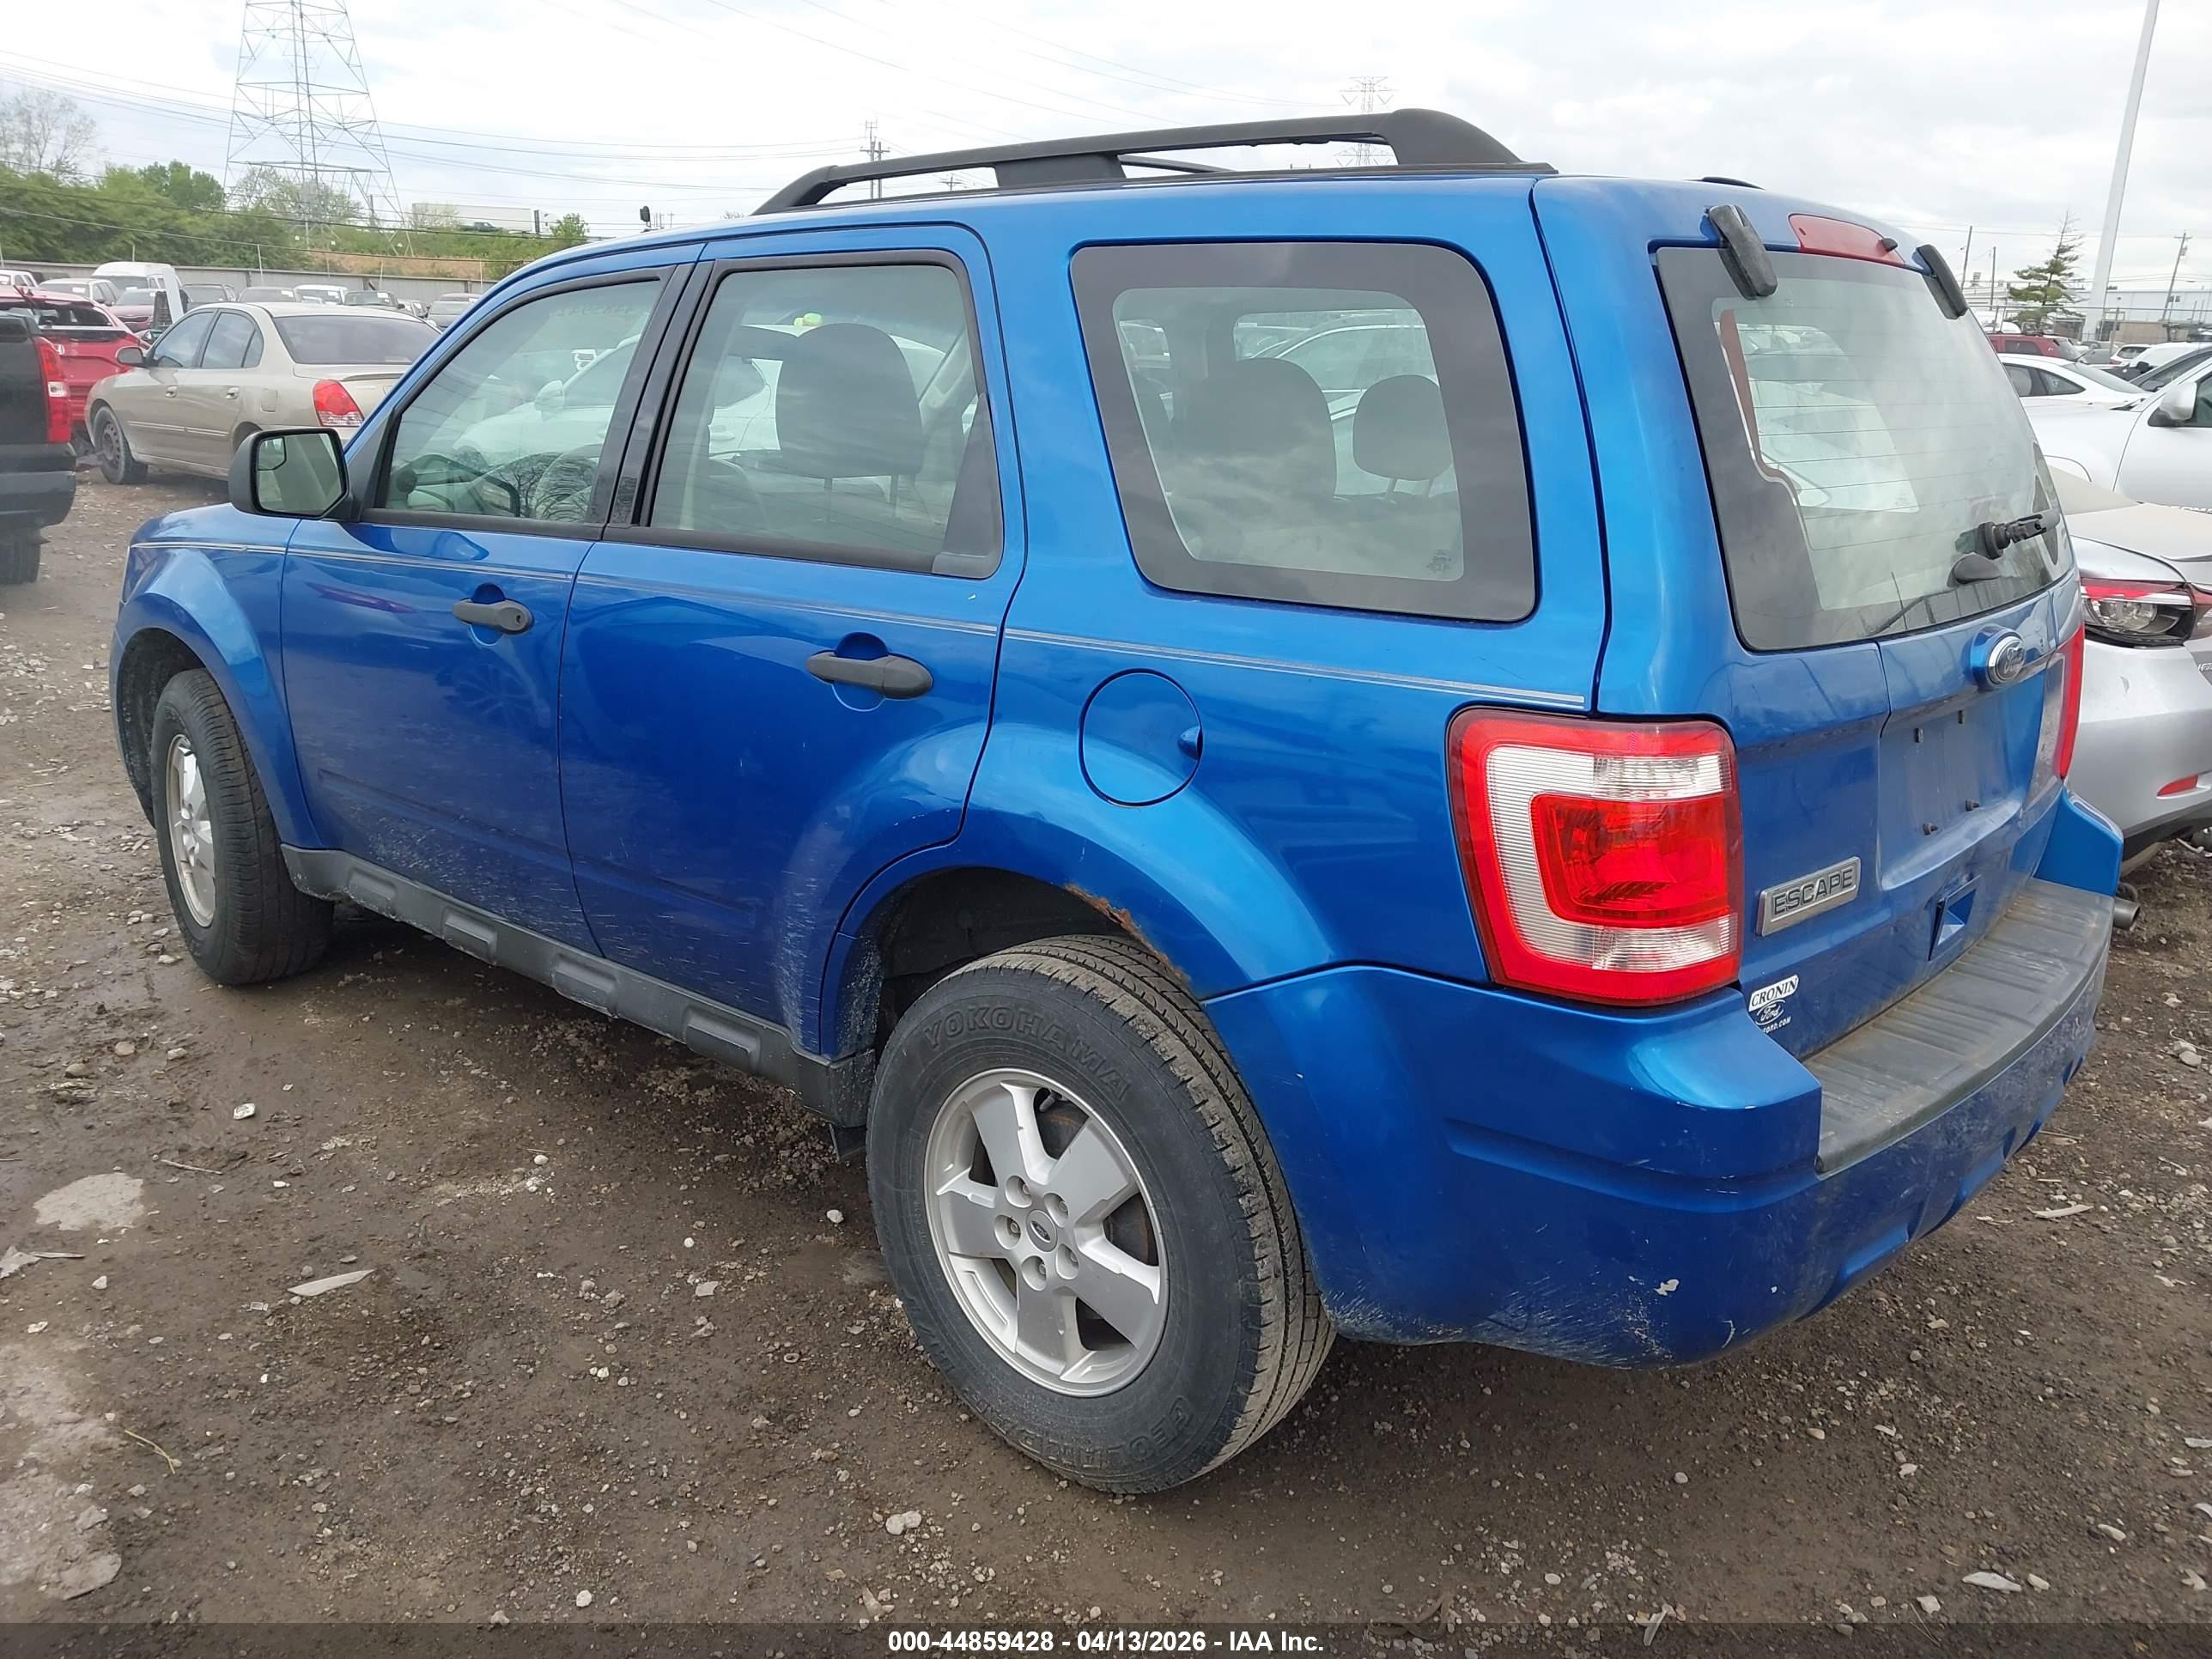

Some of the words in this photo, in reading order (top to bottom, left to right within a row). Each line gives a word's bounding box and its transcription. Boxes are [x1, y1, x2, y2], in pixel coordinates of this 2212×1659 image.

[1772, 868, 1855, 916] ESCAPE
[1751, 977, 1798, 1007] CRONIN
[922, 1005, 1132, 1101] YOKOHAMA
